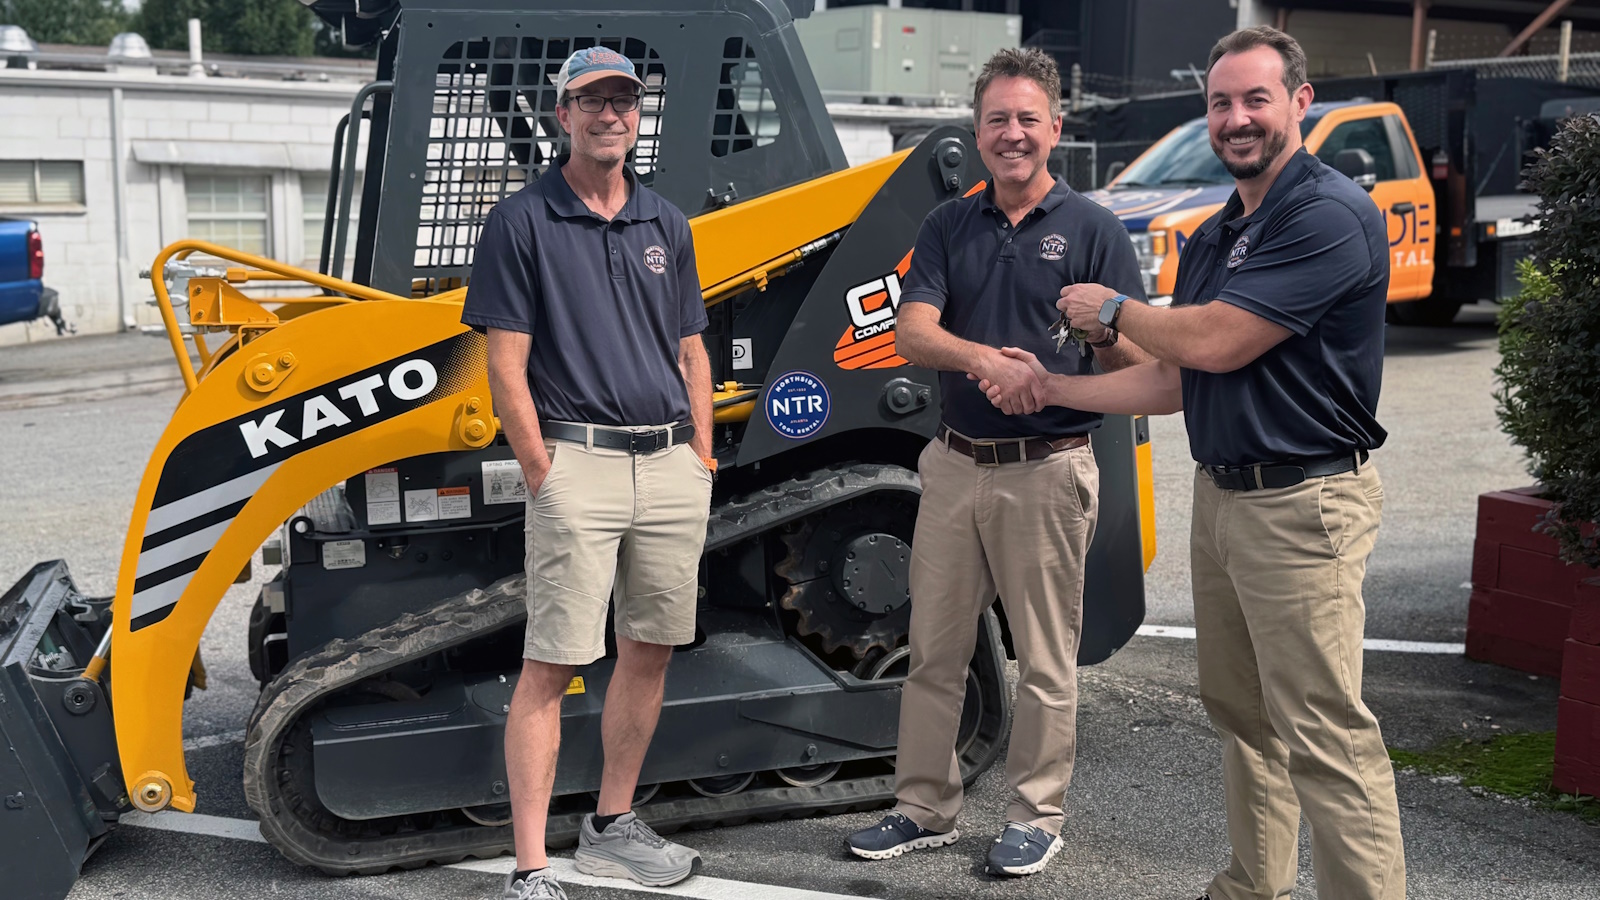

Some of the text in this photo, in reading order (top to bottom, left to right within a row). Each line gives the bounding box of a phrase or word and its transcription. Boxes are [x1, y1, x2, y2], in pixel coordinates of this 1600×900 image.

[1041, 242, 1065, 253] NTR
[1230, 246, 1247, 257] NTR
[646, 255, 665, 265] NTR
[854, 317, 898, 340] COMP
[775, 376, 818, 393] NORTHSIDE
[239, 358, 438, 459] KATO
[772, 394, 823, 417] NTR
[778, 419, 820, 434] TOOL RENTAL
